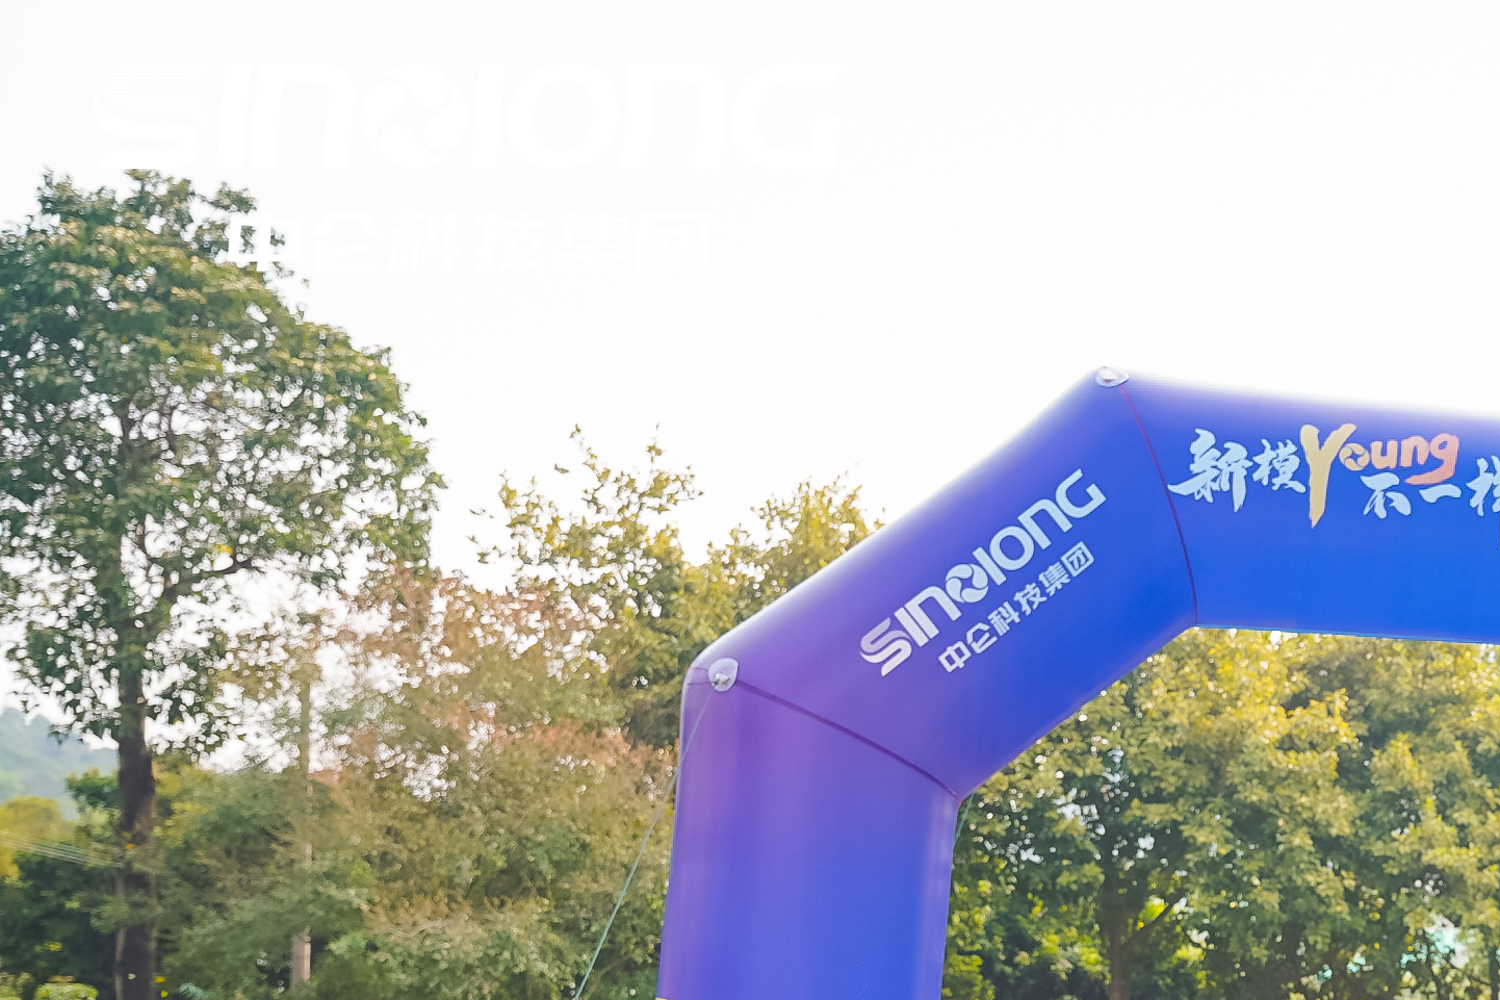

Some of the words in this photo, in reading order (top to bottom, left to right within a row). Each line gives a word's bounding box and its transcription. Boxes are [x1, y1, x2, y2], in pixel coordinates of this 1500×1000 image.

[1167, 428, 1306, 513] 新模
[1300, 423, 1460, 529] Young
[938, 540, 1095, 673] 中仑科技集团
